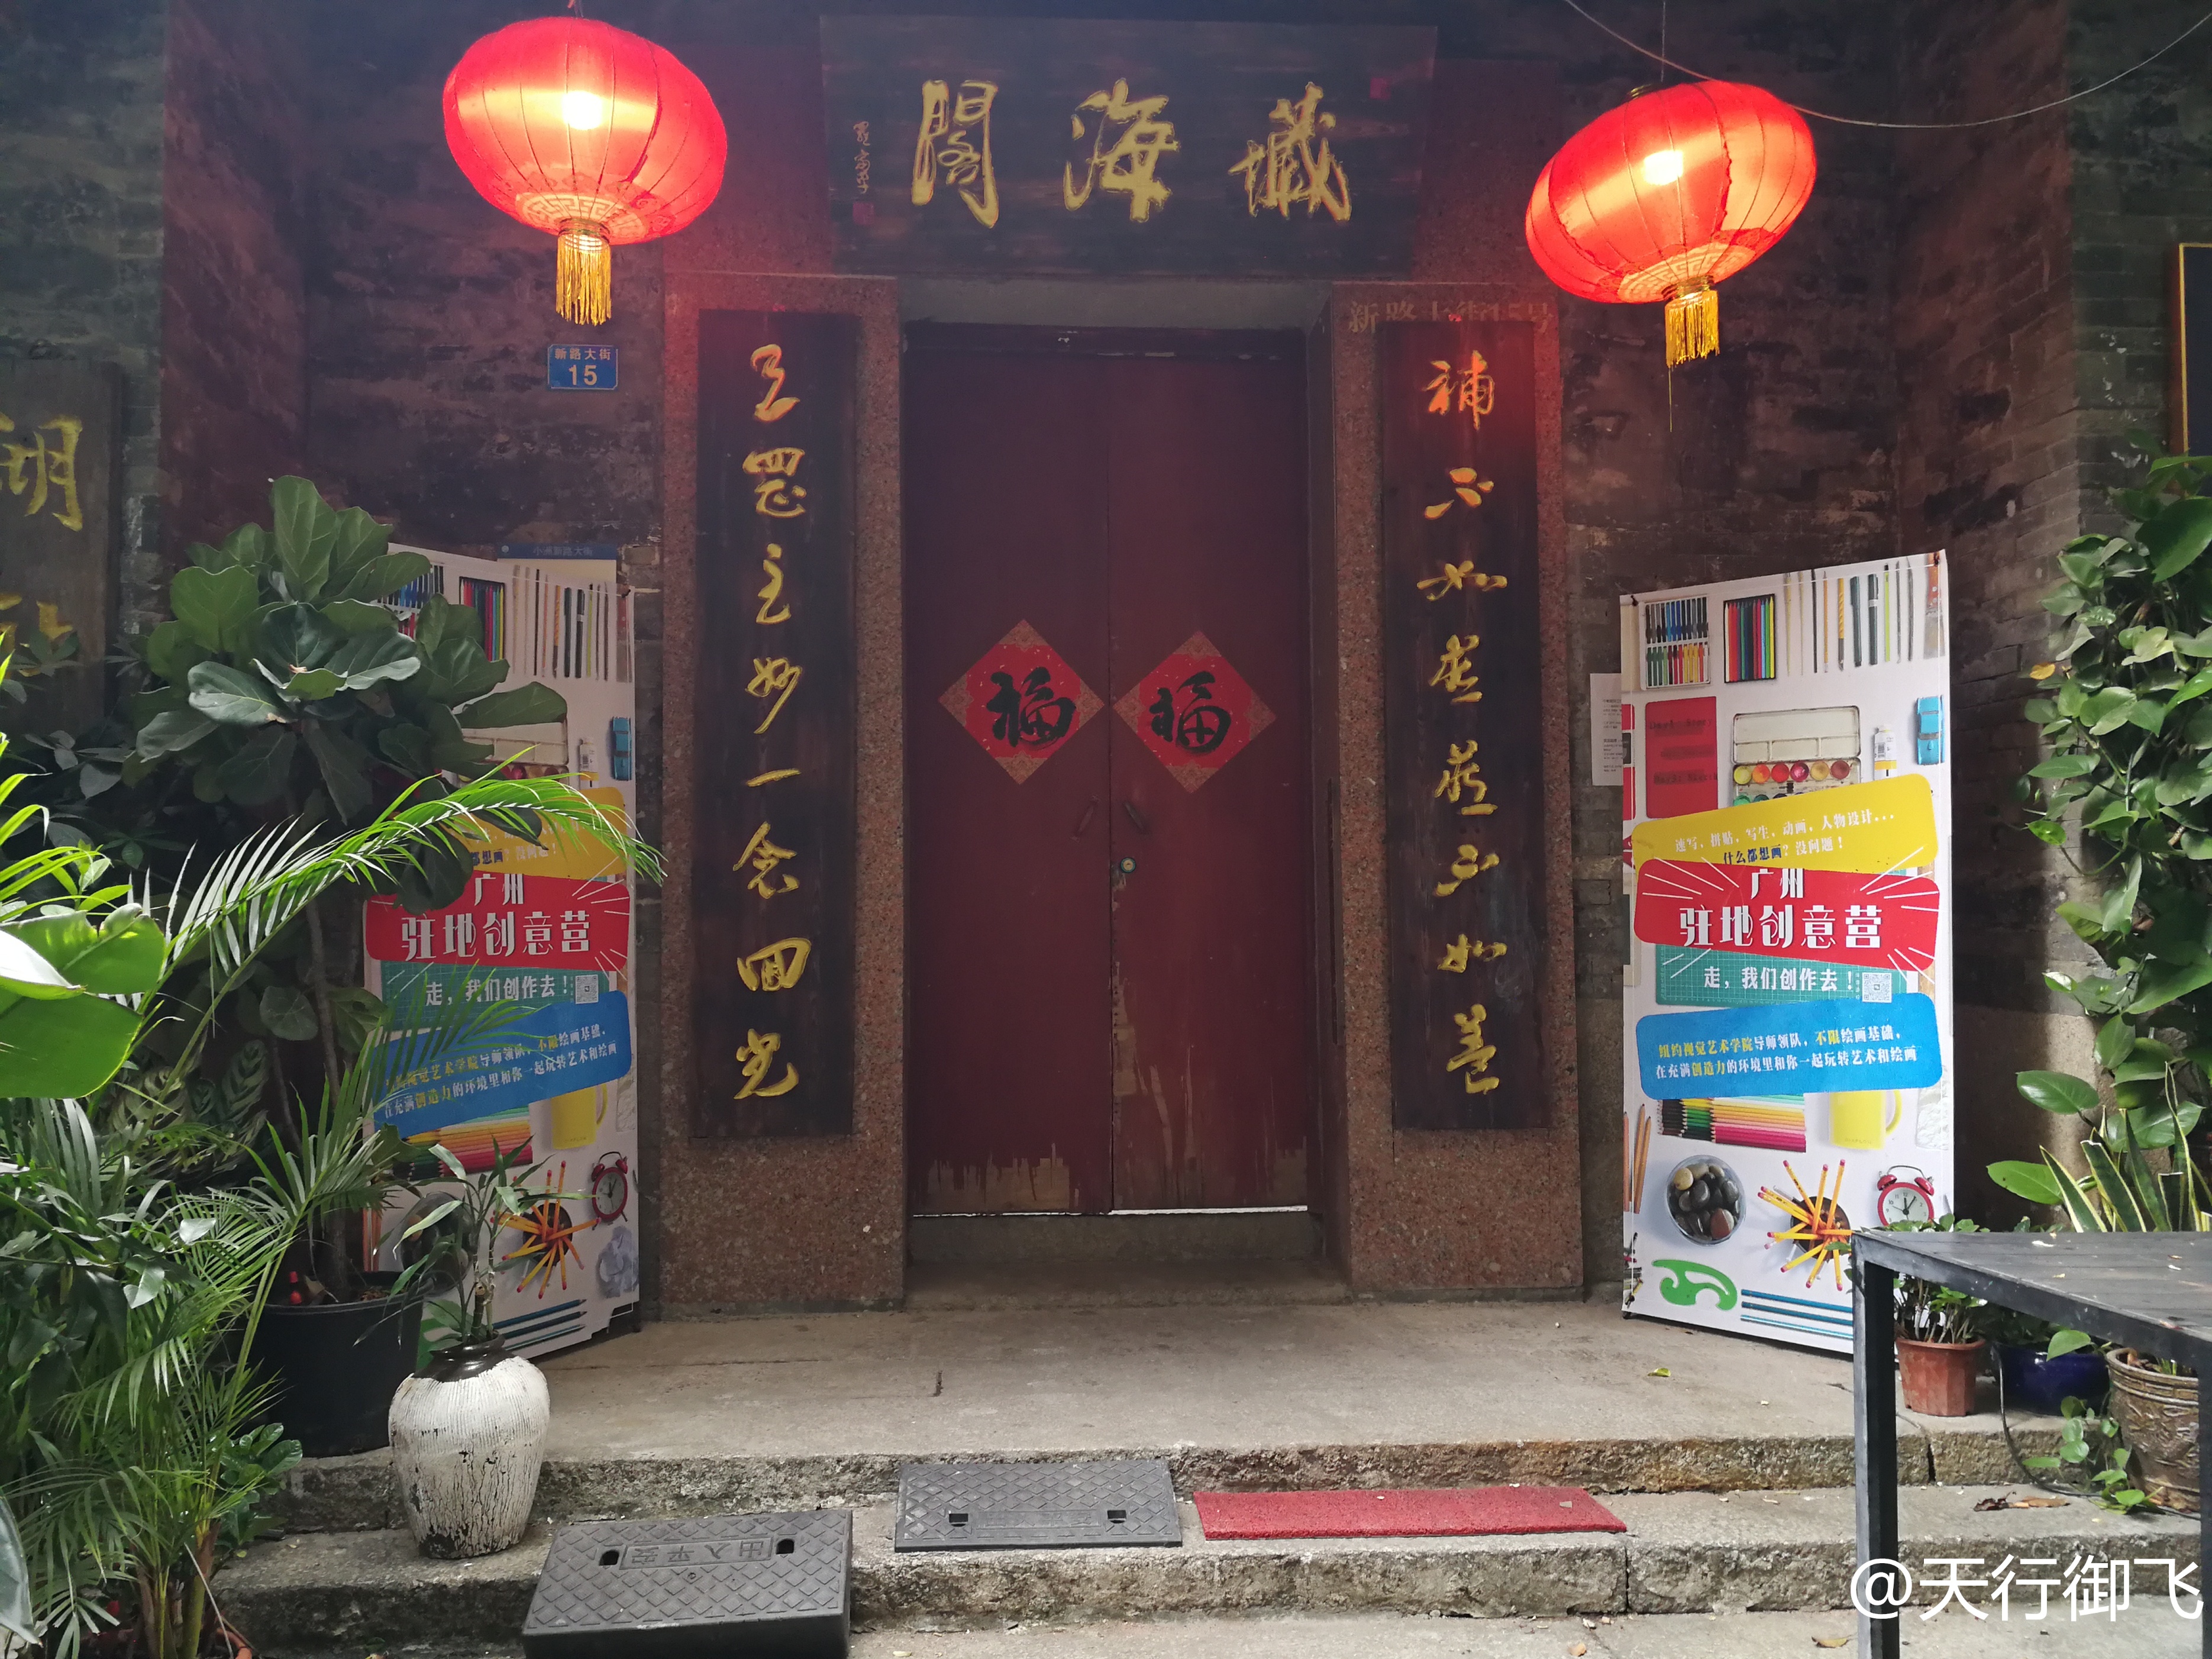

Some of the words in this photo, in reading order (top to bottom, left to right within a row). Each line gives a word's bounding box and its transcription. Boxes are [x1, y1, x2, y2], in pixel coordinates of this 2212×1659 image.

[554, 348, 611, 361] 新路大街
[569, 364, 598, 385] 15
[986, 667, 1076, 750] 福
[1148, 670, 1232, 756] 福
[474, 873, 524, 906] 广州
[1751, 868, 1804, 899] 广州
[401, 910, 589, 961] 驻地创意营
[1680, 905, 1882, 948] 驻地创意营
[631, 1541, 764, 1565] 出入平安
